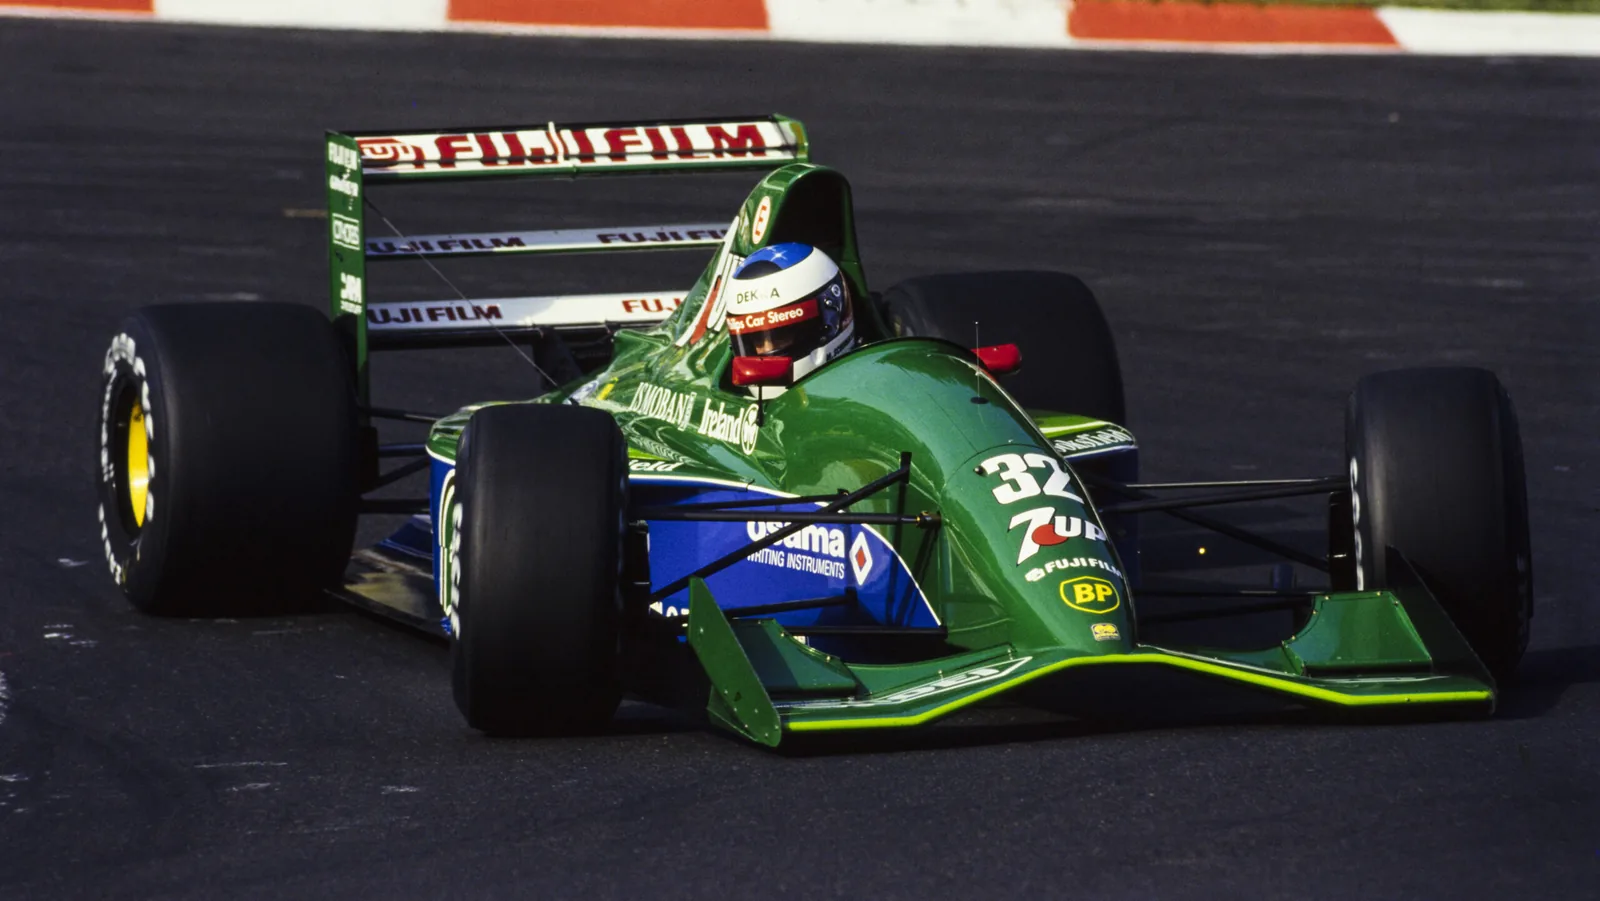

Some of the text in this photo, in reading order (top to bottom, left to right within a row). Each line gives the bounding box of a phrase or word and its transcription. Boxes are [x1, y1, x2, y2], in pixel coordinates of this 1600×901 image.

[368, 236, 526, 253] UJIFILM
[367, 303, 503, 325] UJIFILM
[745, 314, 765, 328] Car
[767, 307, 804, 324] Stereo
[697, 398, 745, 445] Ireland
[979, 452, 1085, 505] 32
[786, 553, 845, 580] INSTRUMENTS
[1072, 583, 1113, 605] BP
